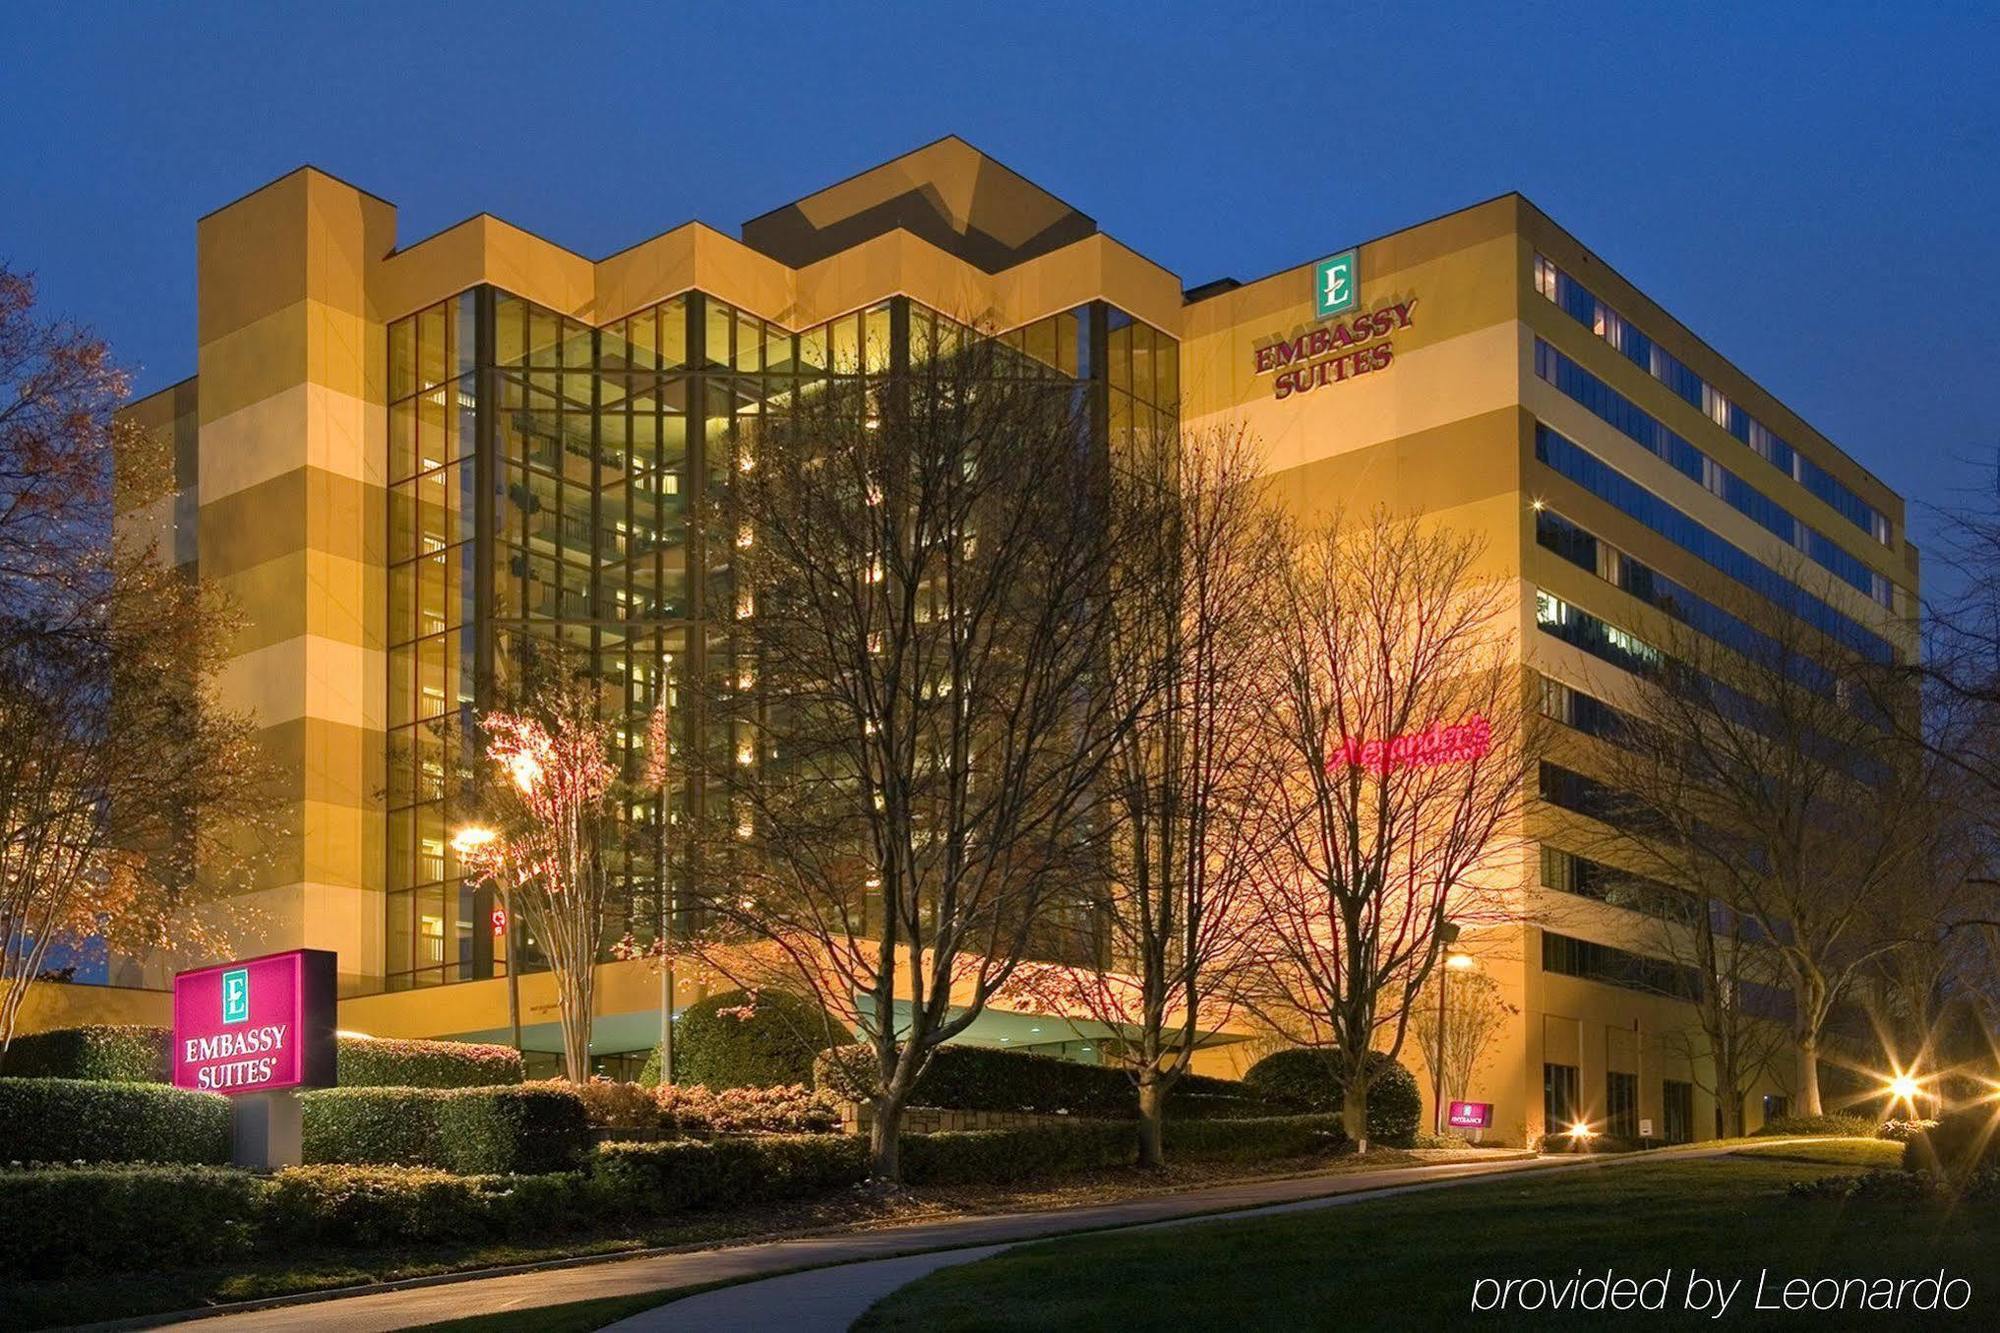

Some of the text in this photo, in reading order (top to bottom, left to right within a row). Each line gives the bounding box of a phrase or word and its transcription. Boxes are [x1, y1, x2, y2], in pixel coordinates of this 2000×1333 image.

[1324, 265, 1348, 306] E
[1255, 299, 1418, 376] EMBASSY
[1275, 342, 1393, 399] SUITES
[227, 978, 244, 1015] E
[185, 1024, 286, 1063] EMBASSY
